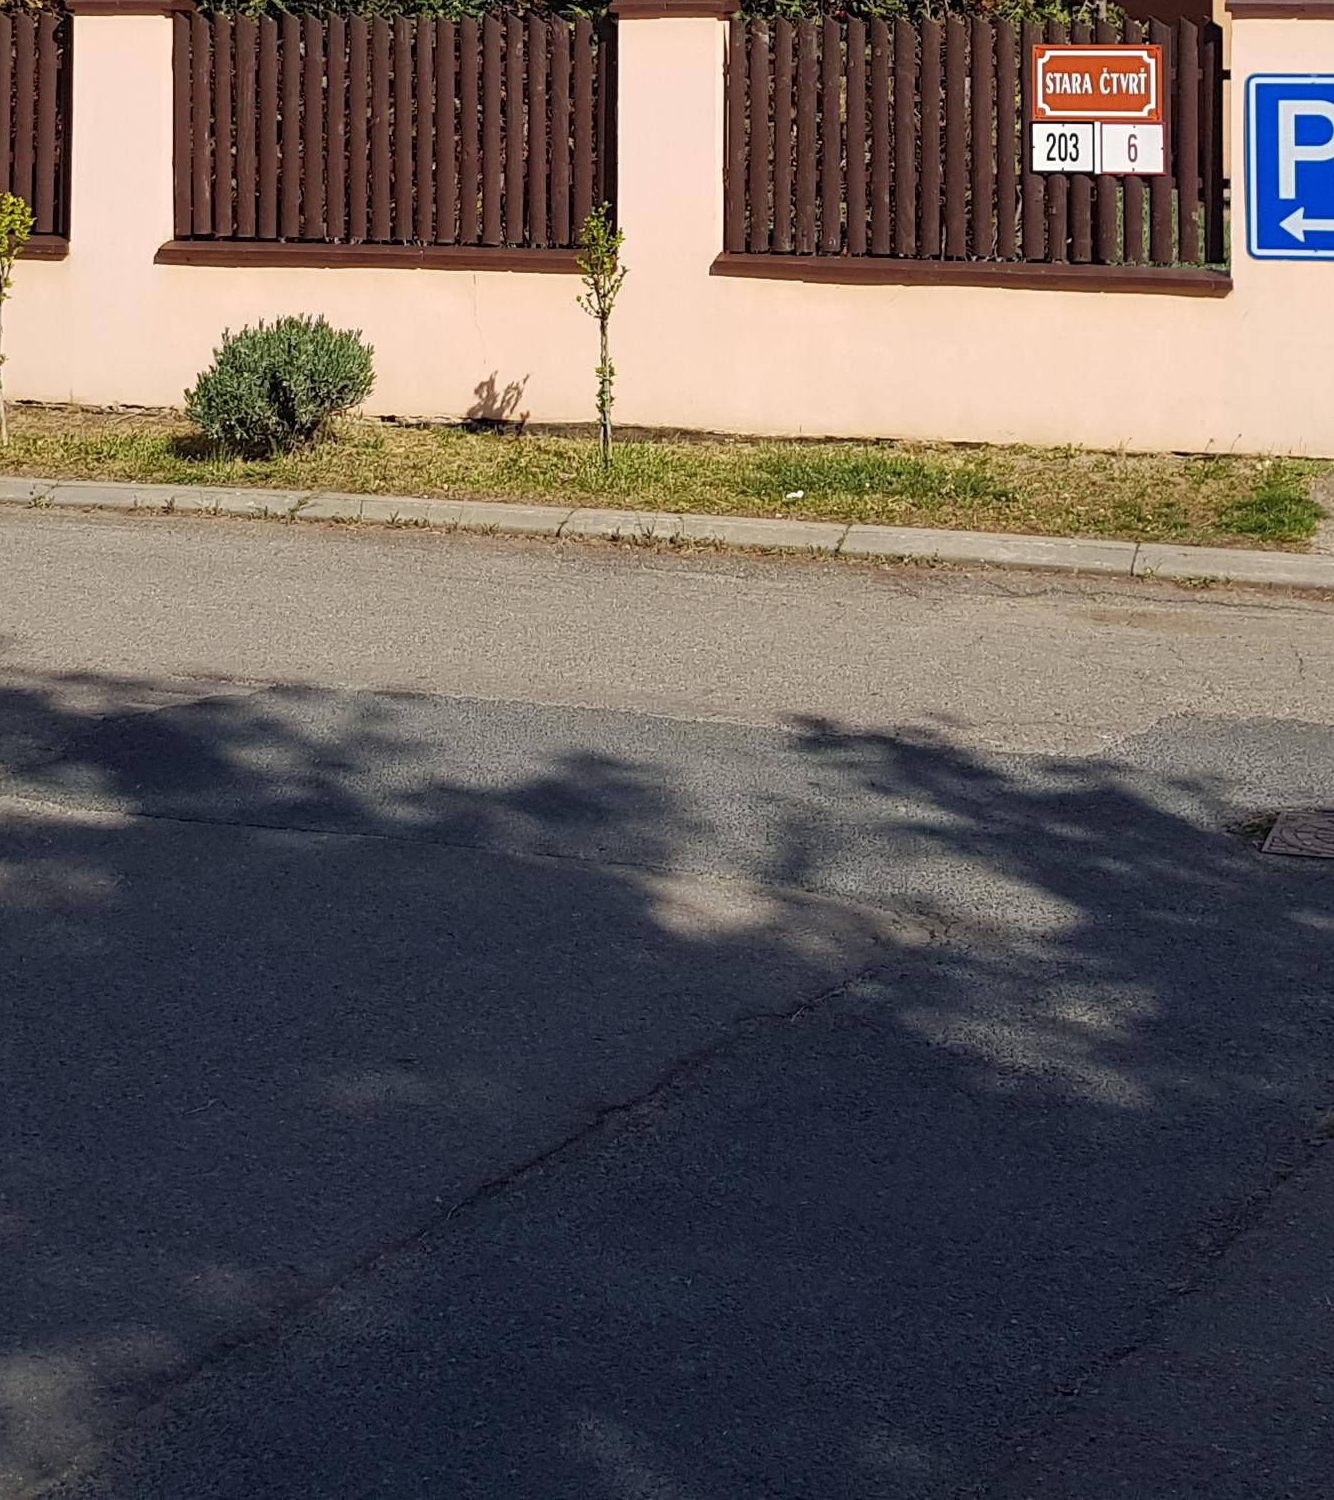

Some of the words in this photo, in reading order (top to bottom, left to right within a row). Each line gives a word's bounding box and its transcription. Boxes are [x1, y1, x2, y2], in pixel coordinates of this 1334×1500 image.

[1045, 72, 1093, 94] STARA
[1099, 67, 1147, 94] ČTVRŤ
[1046, 132, 1079, 162] 203
[1127, 133, 1138, 162] 6
